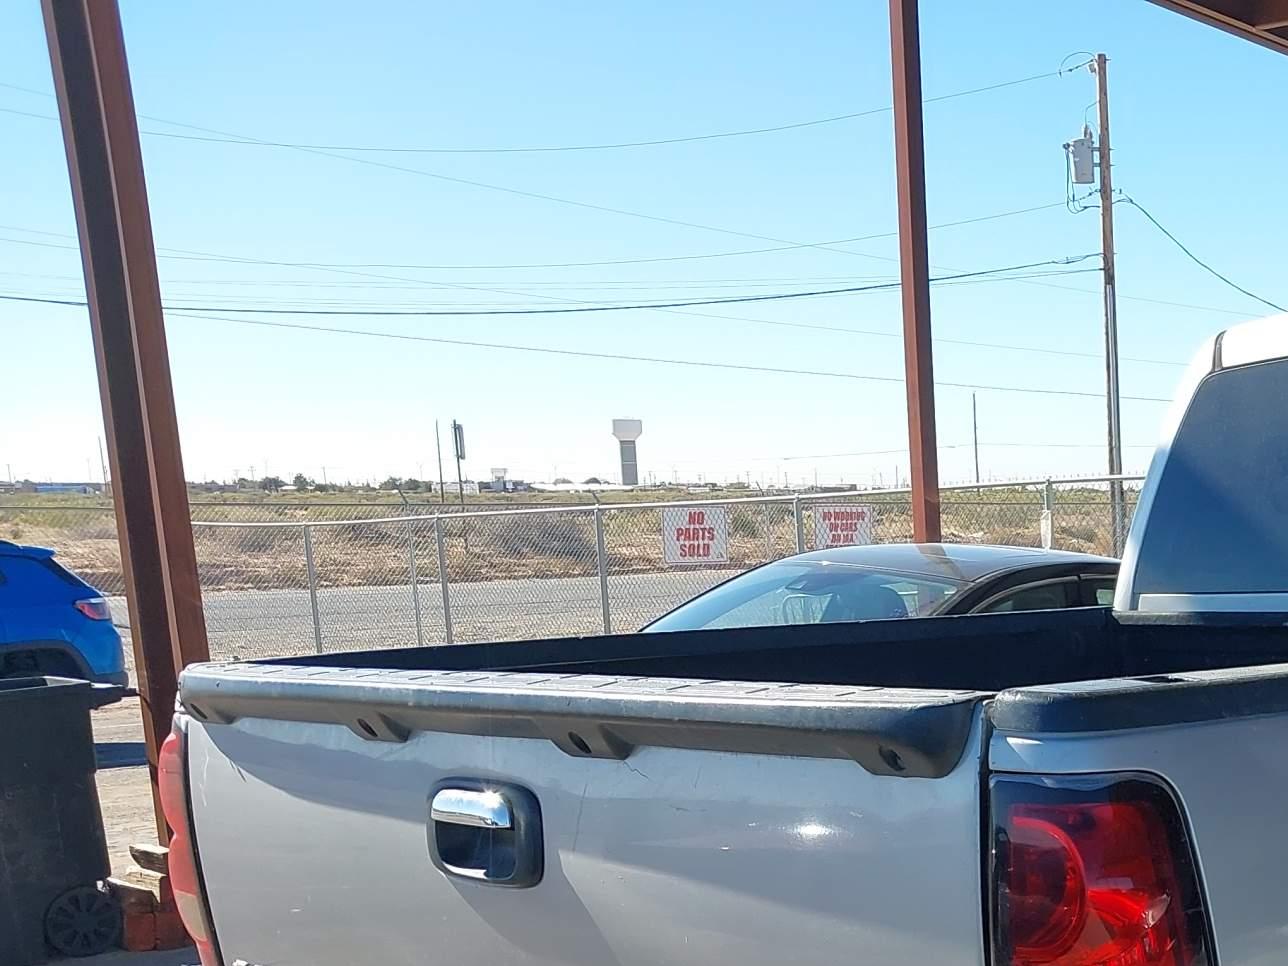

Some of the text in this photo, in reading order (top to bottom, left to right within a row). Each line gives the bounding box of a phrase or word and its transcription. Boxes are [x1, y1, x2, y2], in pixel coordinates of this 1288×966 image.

[688, 511, 705, 525] NO
[822, 511, 832, 521] NO
[840, 522, 858, 532] CARS
[676, 527, 715, 542] PARTS
[680, 543, 711, 557] SOLD
